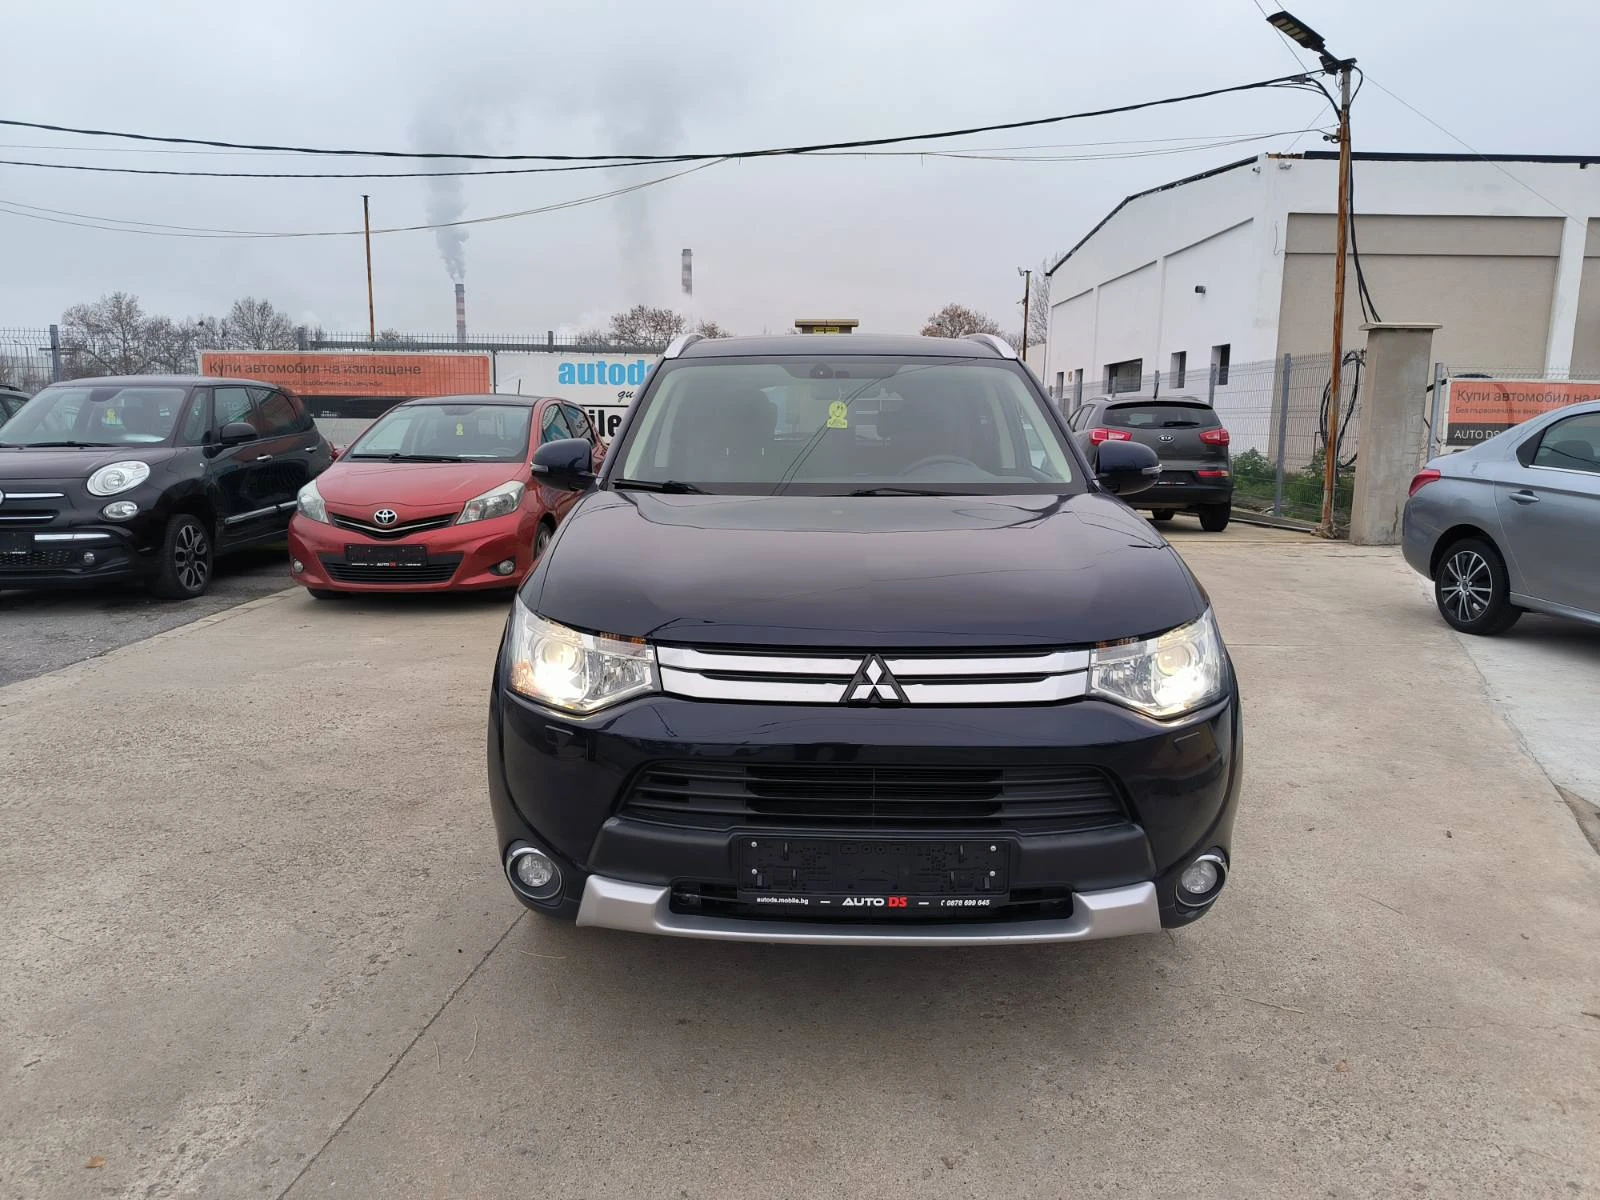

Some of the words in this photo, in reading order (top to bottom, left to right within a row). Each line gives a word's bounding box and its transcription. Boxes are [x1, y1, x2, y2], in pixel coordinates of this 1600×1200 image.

[209, 361, 241, 376] Купи
[245, 362, 319, 374] автомобил
[323, 364, 340, 374] на
[344, 364, 421, 376] изплащане
[1457, 389, 1489, 404] Купи
[1494, 391, 1569, 403] автомобил
[1574, 393, 1590, 402] на
[1454, 430, 1484, 439] AUTO
[842, 897, 885, 906] AUTO
[888, 896, 908, 907] DS
